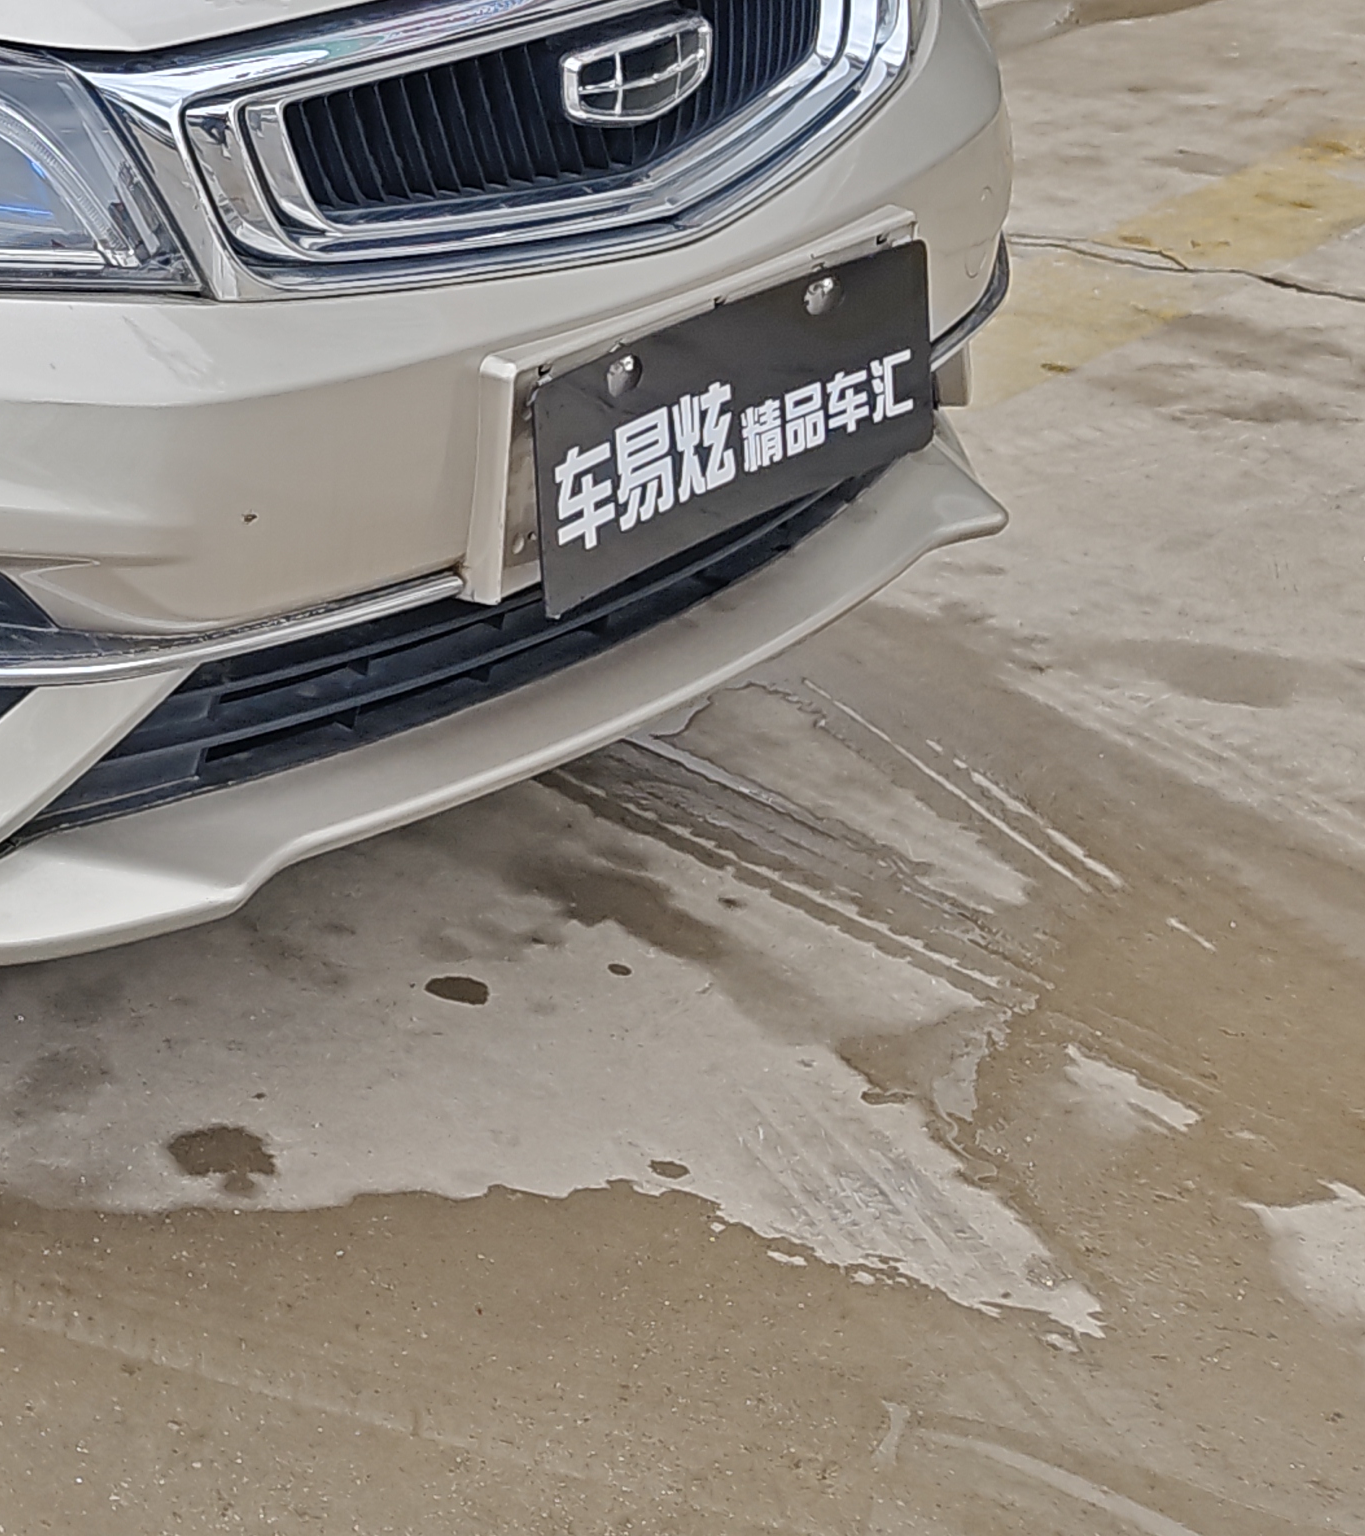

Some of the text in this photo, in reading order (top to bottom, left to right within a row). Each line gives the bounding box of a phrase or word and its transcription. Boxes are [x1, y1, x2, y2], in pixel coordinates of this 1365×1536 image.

[554, 348, 914, 550] 车易炫 精品车汇
